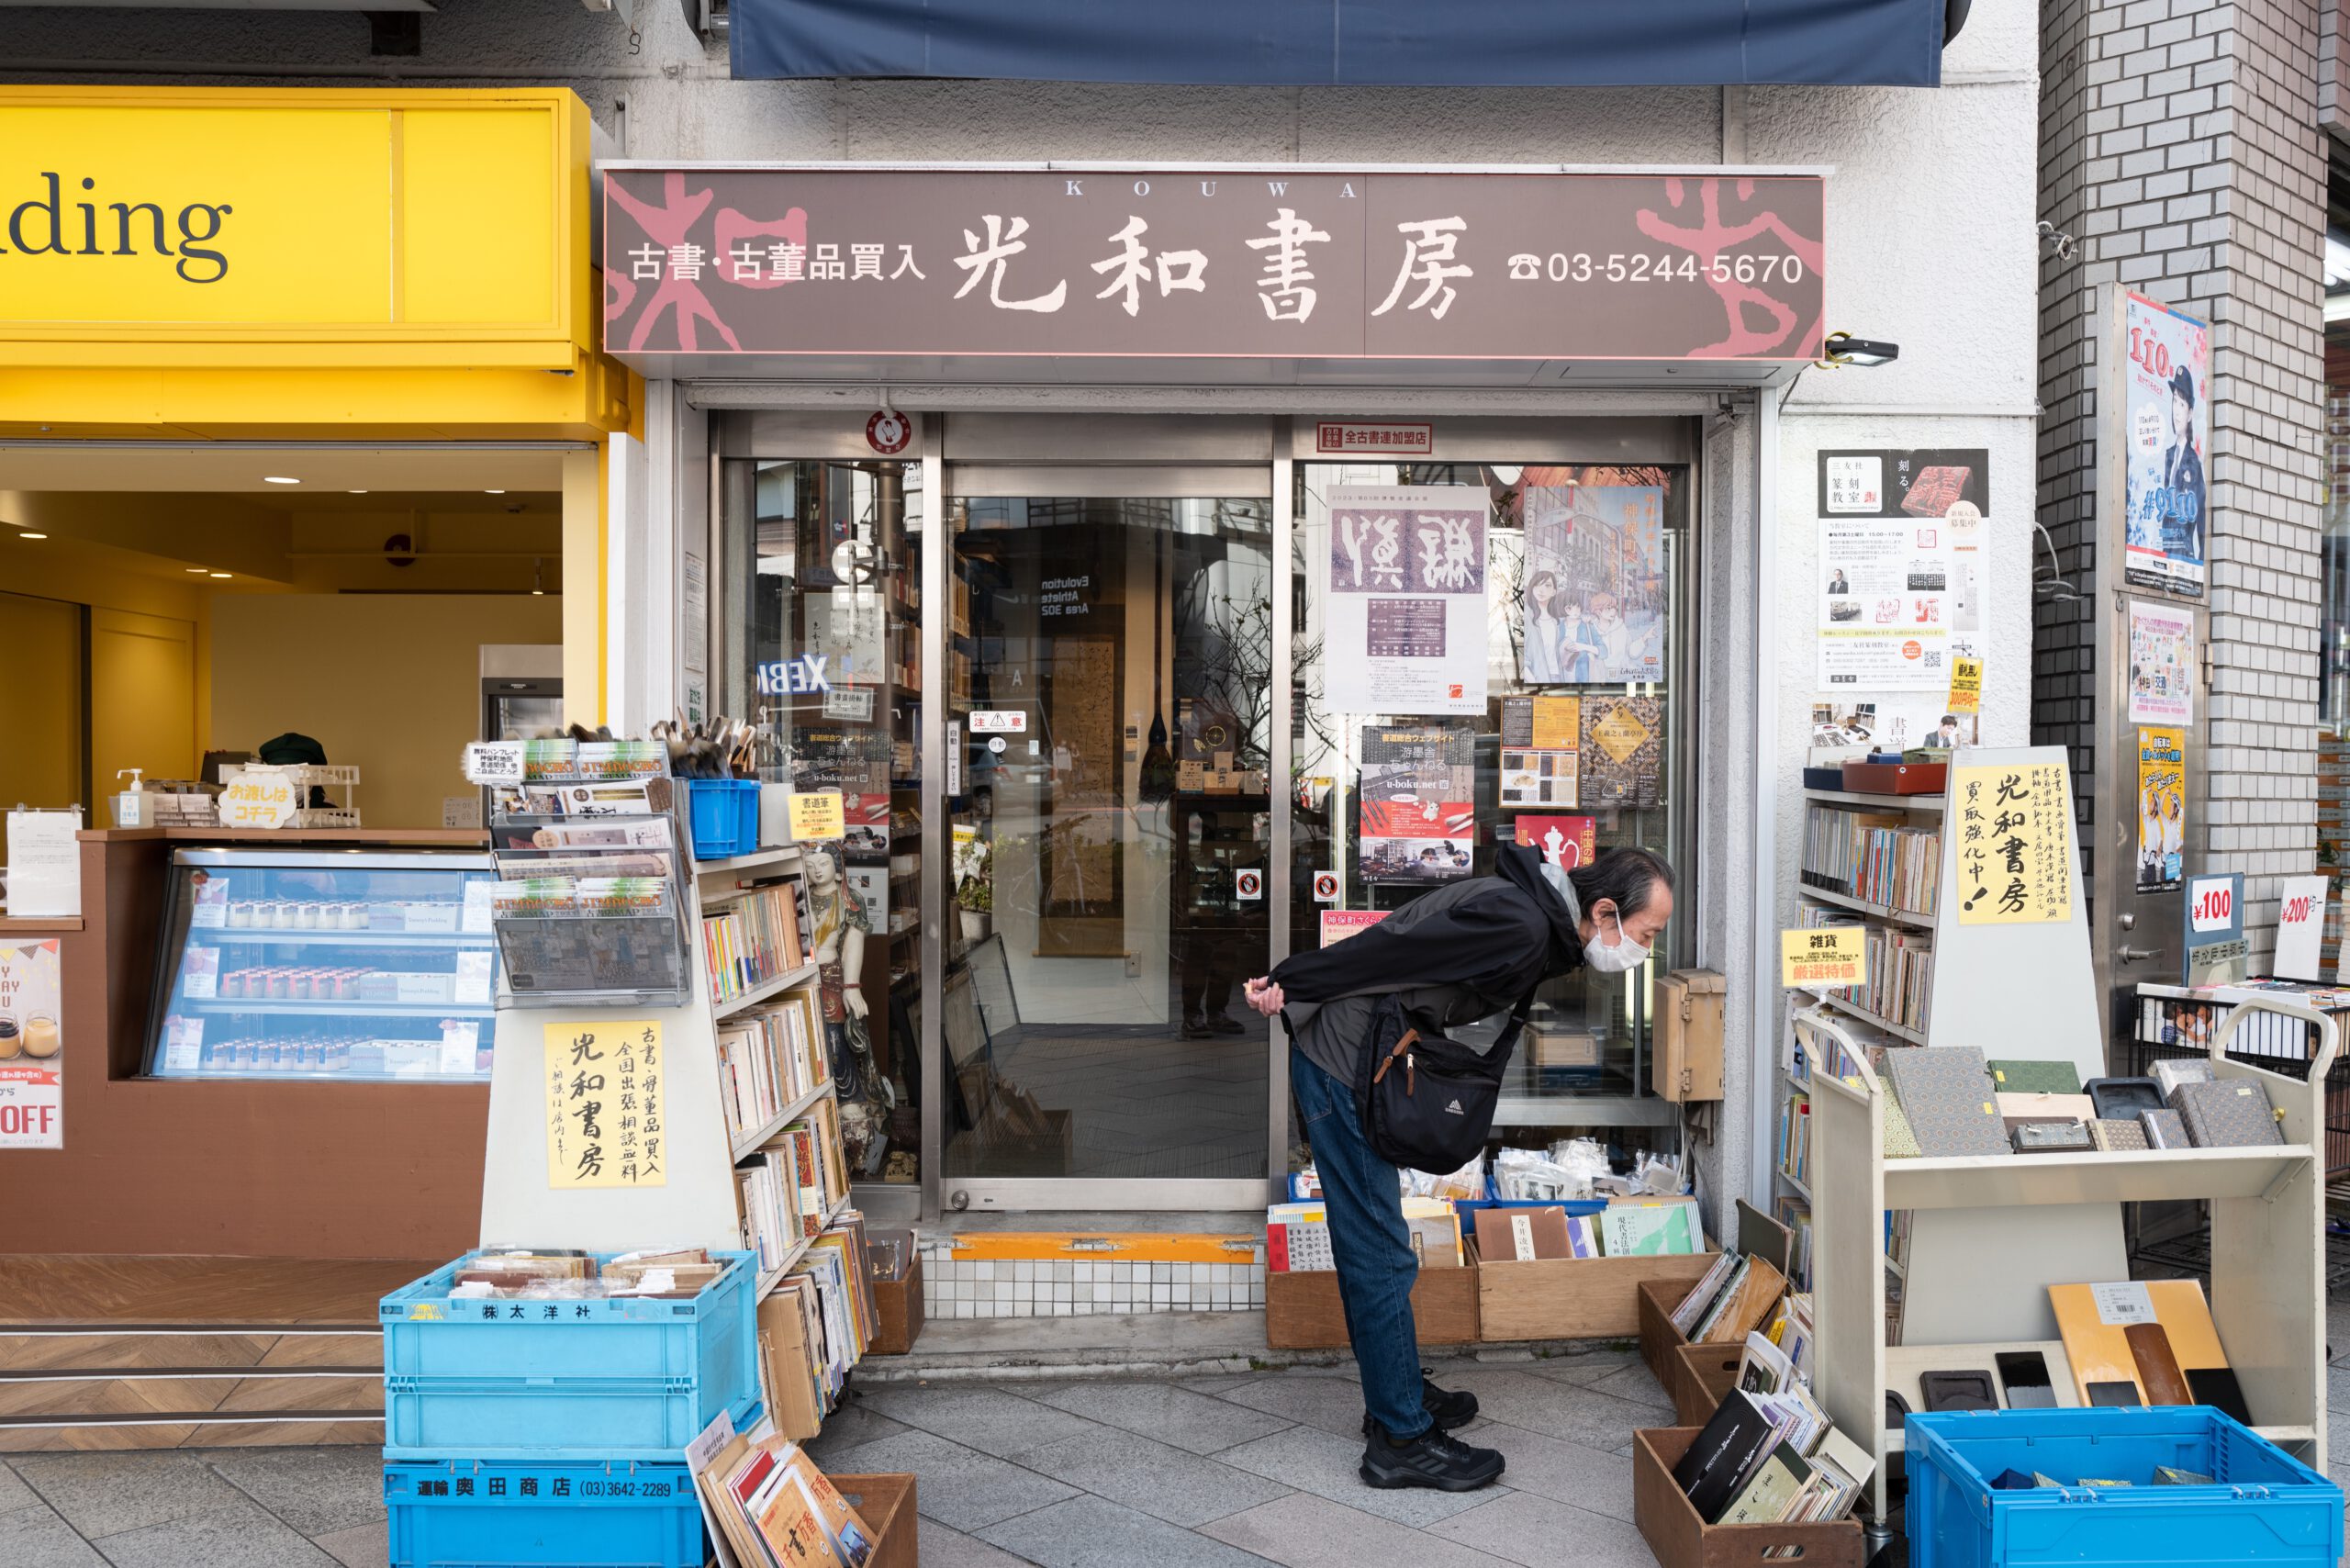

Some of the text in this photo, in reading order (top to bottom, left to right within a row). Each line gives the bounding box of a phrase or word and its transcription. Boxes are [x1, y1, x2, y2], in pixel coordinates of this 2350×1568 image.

[0, 172, 233, 284] ding
[953, 208, 1473, 323] 光和書房
[1549, 252, 1803, 284] 03-5244-5670
[1345, 431, 1427, 445] 全古書連加盟店
[1831, 491, 1860, 503] 教室
[1390, 759, 1447, 771] ちゃんねる
[1386, 778, 1437, 789] u-boku.net
[229, 784, 289, 802] お渡しは
[802, 797, 830, 808] 書道筆
[235, 806, 277, 823] コチラ
[1991, 774, 2030, 914] 光和書房
[2193, 890, 2232, 921] ¥100
[1809, 935, 1838, 948] 雑貨
[1793, 963, 1856, 980] 厳選特価
[569, 1033, 605, 1181] 光和書房
[614, 1041, 639, 1183] 全国出張相談無料
[1, 1105, 57, 1134] OFF
[418, 1478, 671, 1497] 運輸 奥田商店 (03)3642-2289
